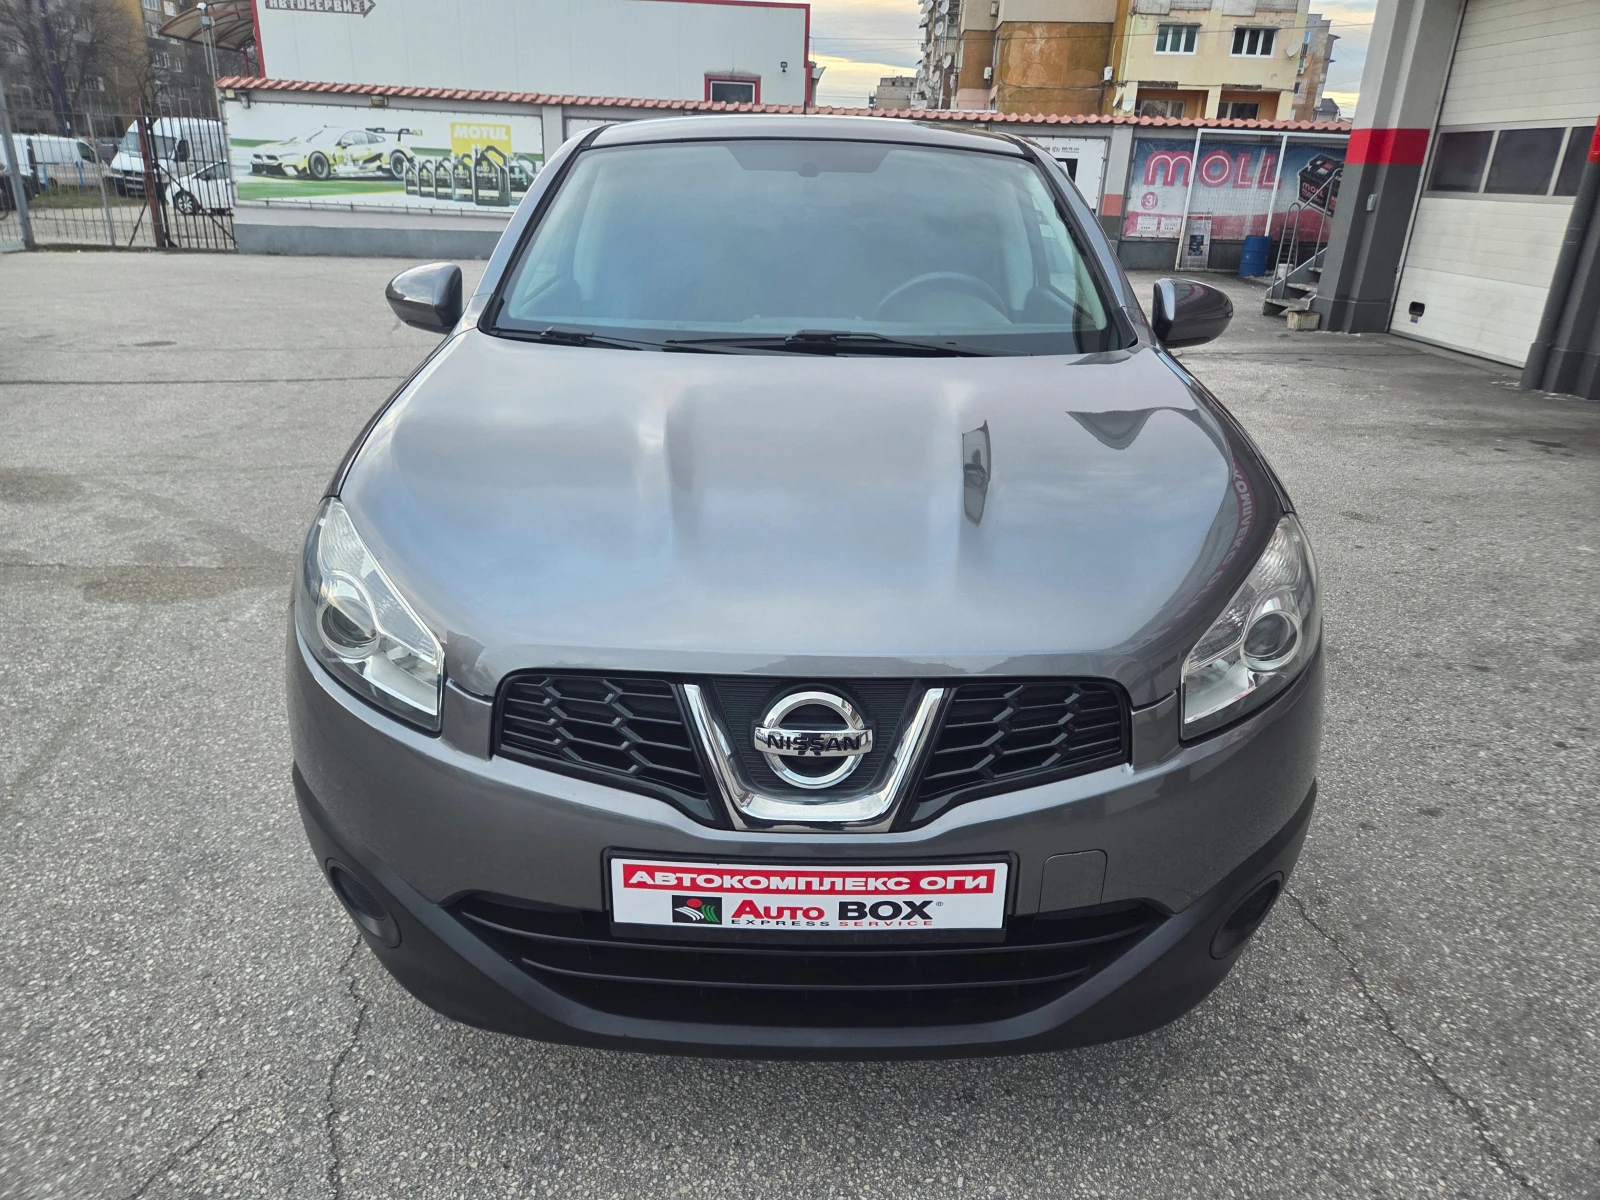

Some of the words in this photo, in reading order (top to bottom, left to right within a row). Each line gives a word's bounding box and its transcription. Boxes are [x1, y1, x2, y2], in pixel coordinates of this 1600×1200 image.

[453, 125, 509, 140] MOTUL
[767, 734, 861, 752] NISSAN
[628, 870, 911, 891] АВТОКОМПЛЕКС
[919, 875, 988, 890] ОГИ
[731, 919, 830, 927] EXPRESS
